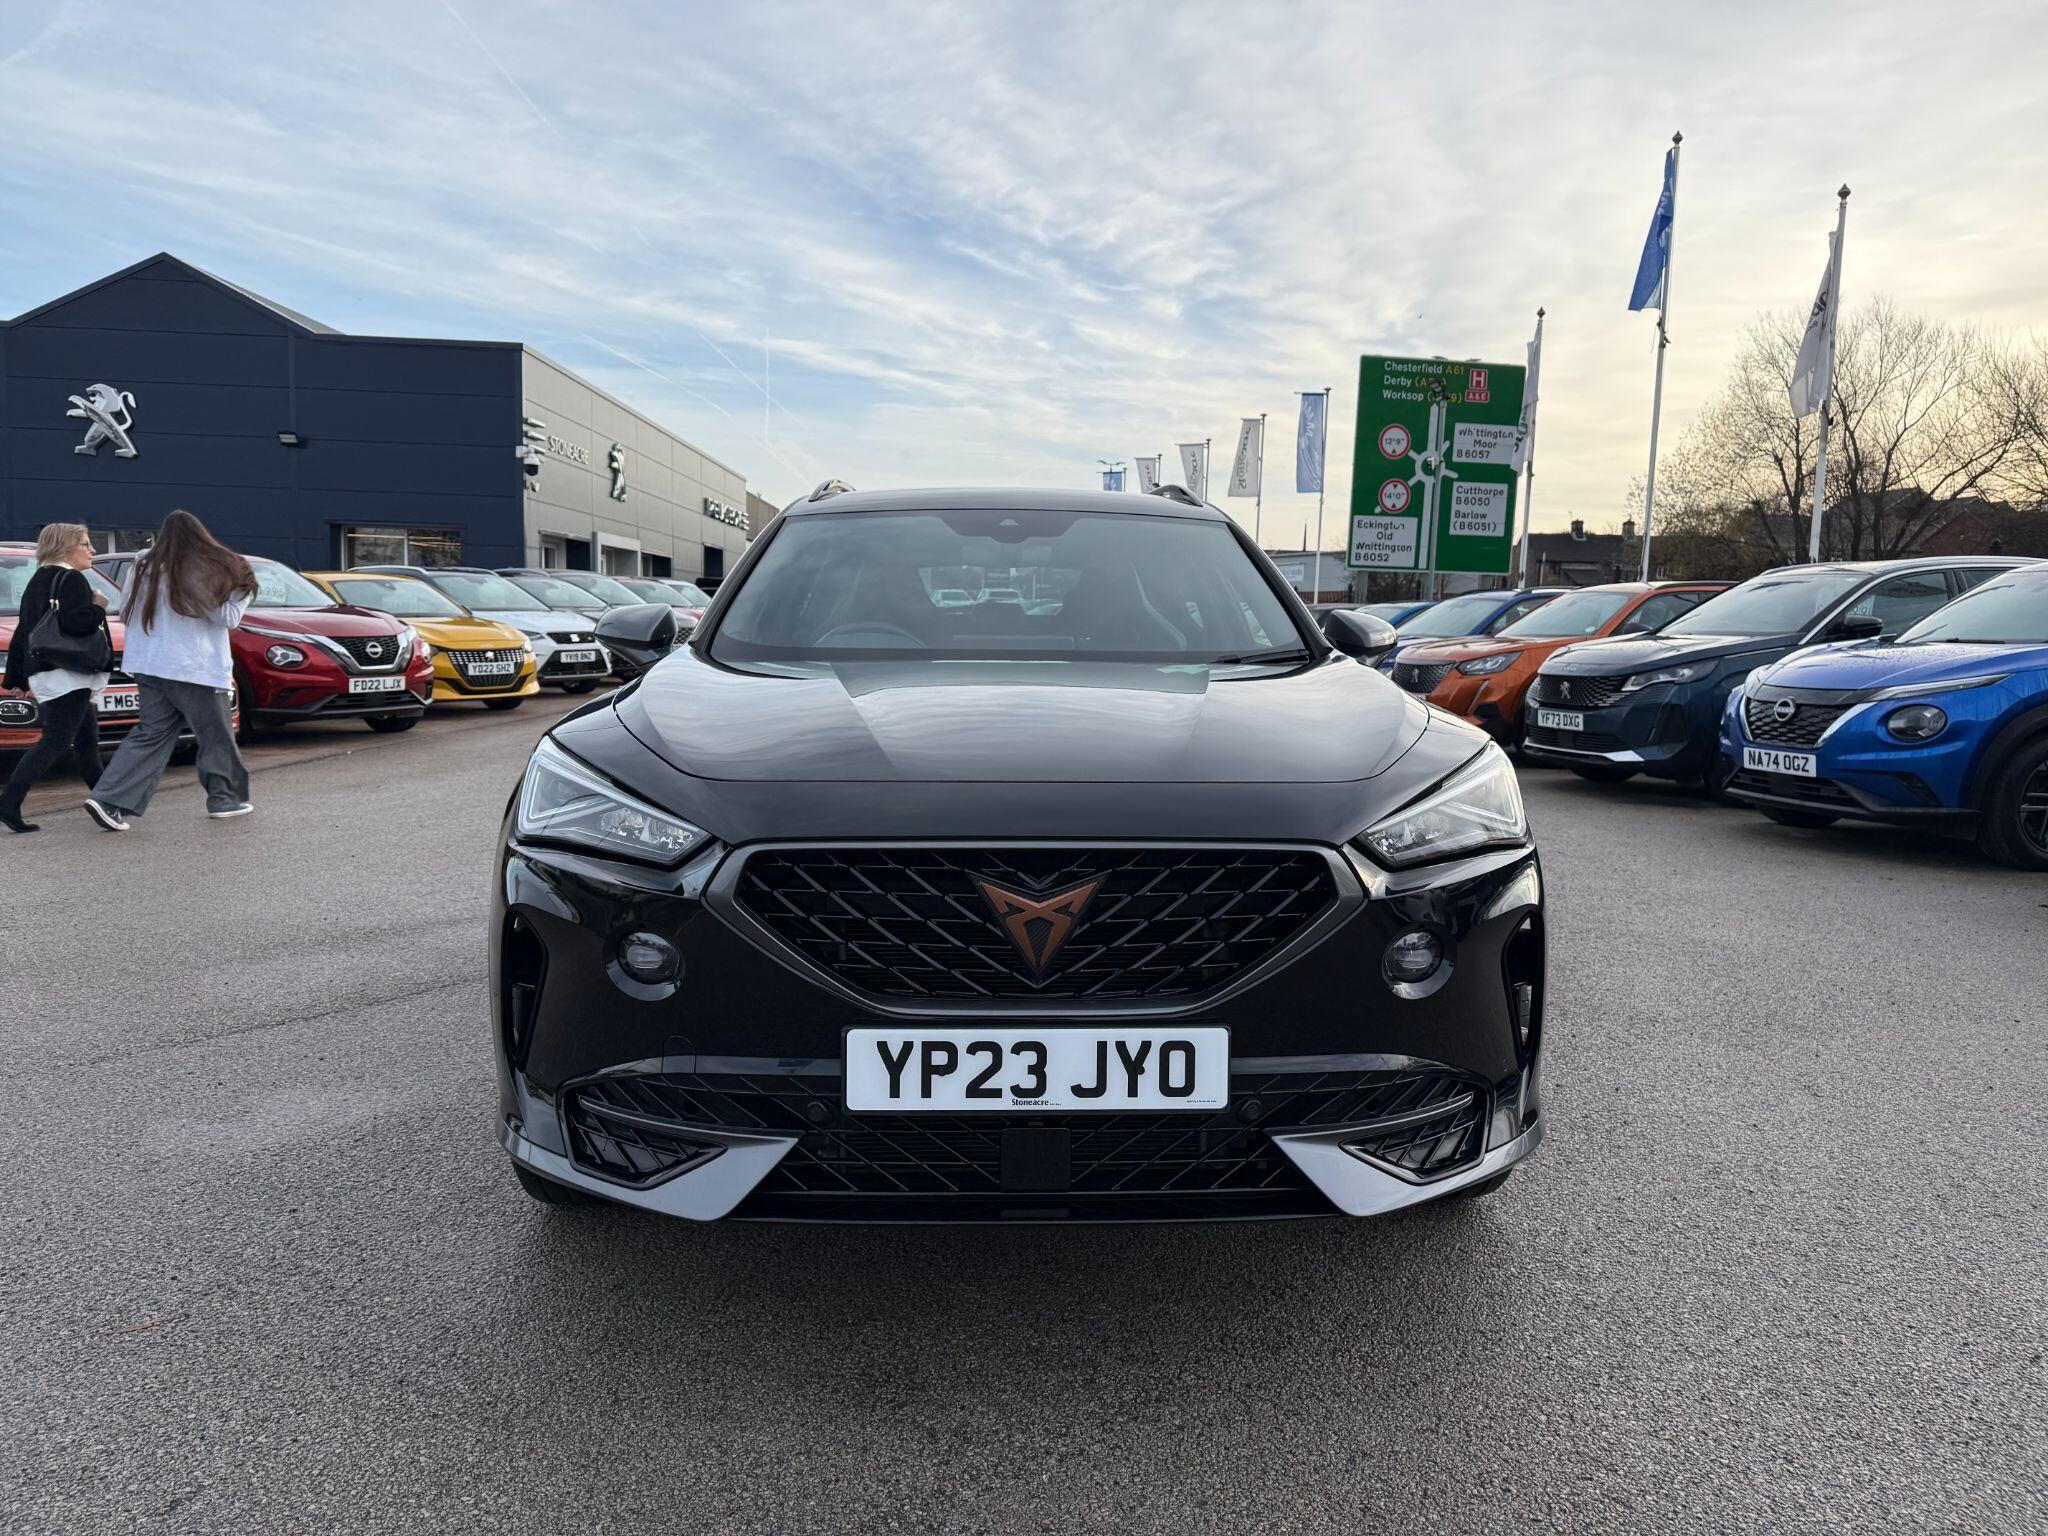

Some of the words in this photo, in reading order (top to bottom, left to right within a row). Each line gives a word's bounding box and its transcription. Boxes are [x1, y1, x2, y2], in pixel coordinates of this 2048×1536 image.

[1384, 361, 1443, 374] Chesterfield
[1446, 365, 1465, 375] A61
[1384, 375, 1412, 387] Derby
[1472, 371, 1485, 388] H
[1382, 389, 1424, 402] Worksop
[1458, 428, 1514, 439] Whttington
[1473, 439, 1497, 448] Moor
[550, 435, 589, 465] STONEACRE
[1456, 485, 1504, 497] Cutthorpe
[1454, 510, 1488, 519] Barlow
[1357, 519, 1405, 531] Eckington
[1376, 531, 1393, 541] Old
[1355, 542, 1412, 553] Whittington
[471, 664, 494, 673] YD22
[495, 663, 511, 672] SHZ
[353, 679, 381, 691] FD22
[383, 678, 402, 689] LJX
[1540, 710, 1561, 726] YF73
[1562, 712, 1580, 728] DXG
[1748, 750, 1780, 768] NA74
[1783, 754, 1809, 773] OGZ
[876, 1040, 1047, 1099] YP23
[1070, 1040, 1196, 1099] JYO
[1011, 1098, 1050, 1106] Stoneacre
